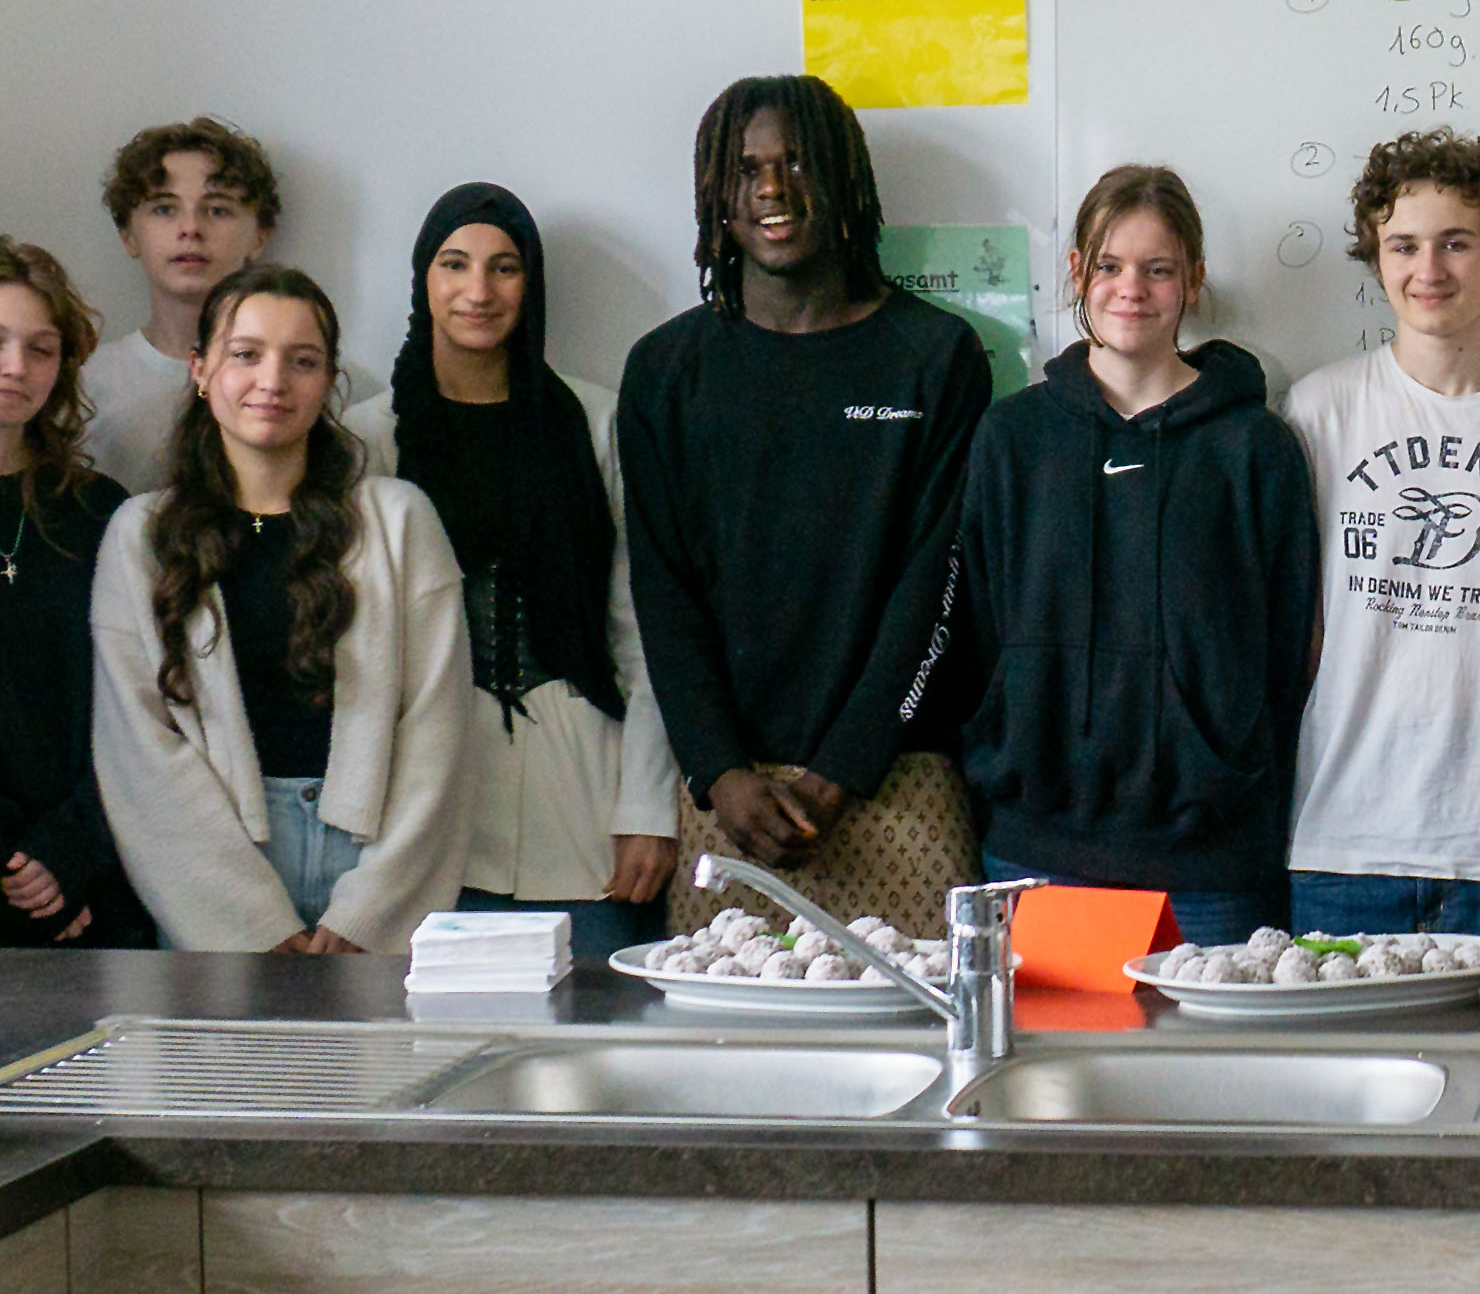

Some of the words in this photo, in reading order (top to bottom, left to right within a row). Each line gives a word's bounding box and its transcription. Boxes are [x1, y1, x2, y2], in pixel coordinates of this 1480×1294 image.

[1375, 86, 1420, 114] 1,5
[1340, 512, 1385, 526] TRADE
[1344, 527, 1377, 559] 06
[1349, 576, 1363, 591] IN
[1368, 578, 1421, 600] DENIM
[1428, 585, 1454, 601] WE
[899, 623, 950, 722] Dreams
